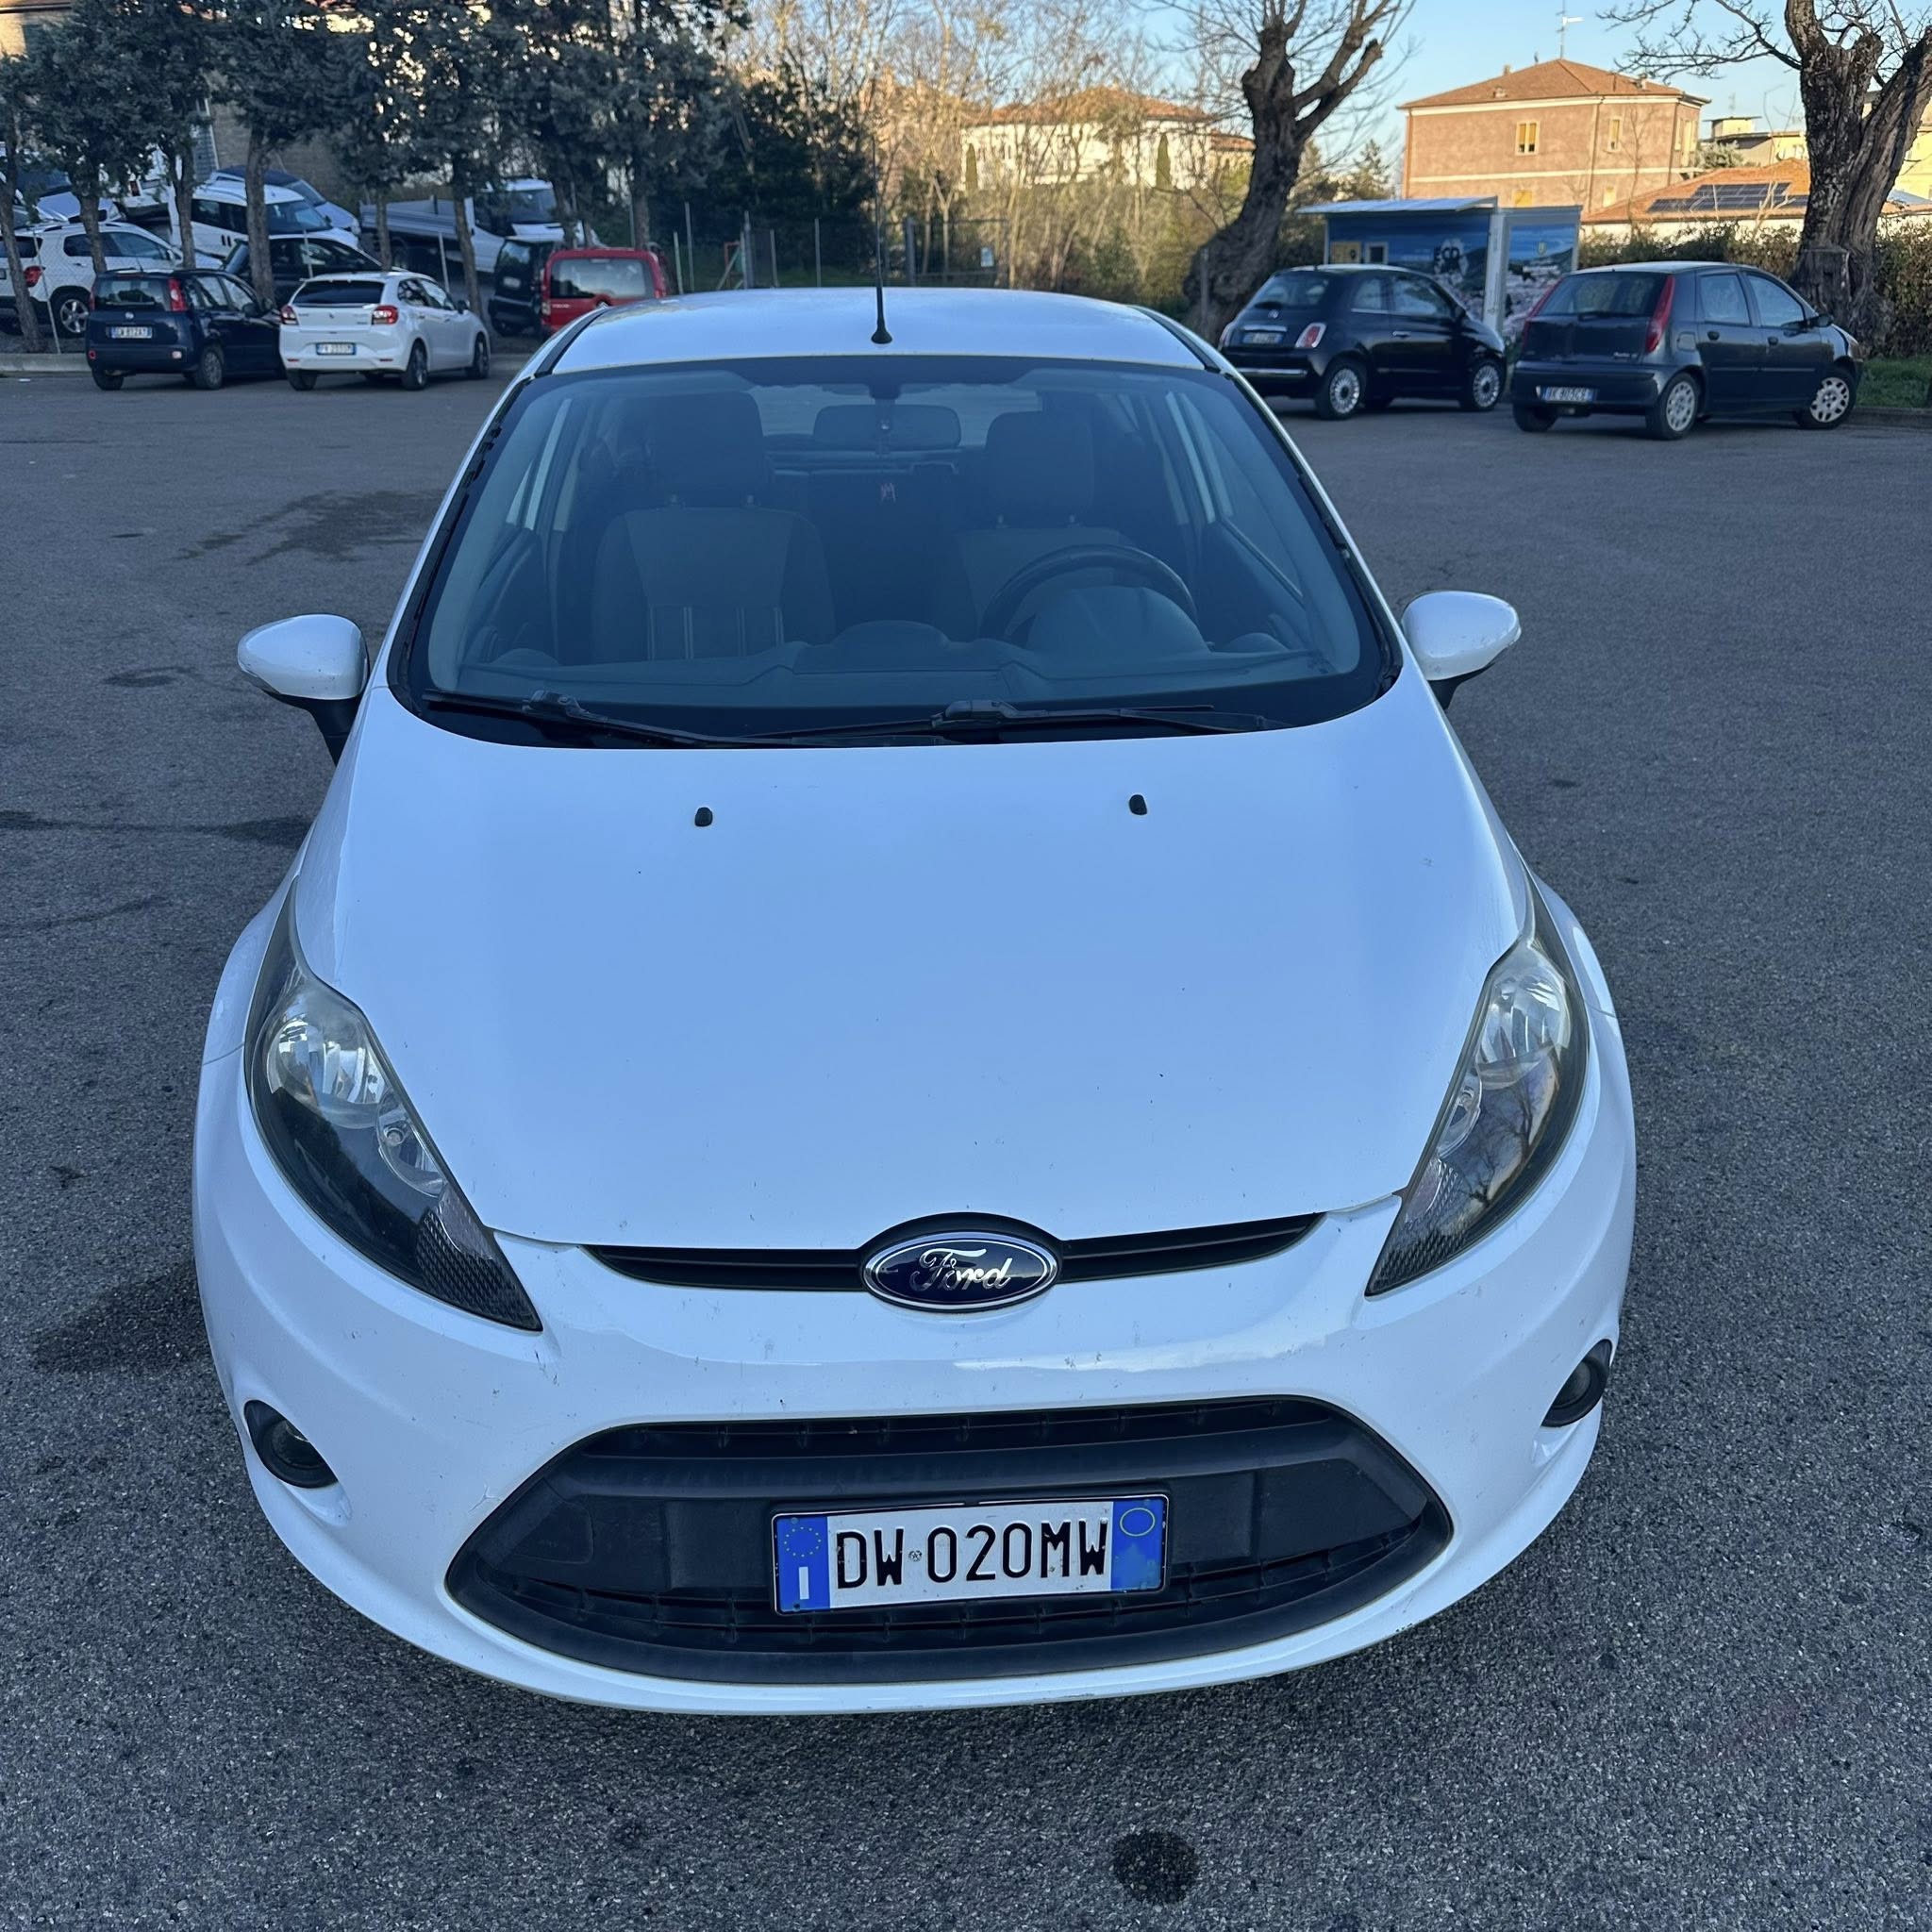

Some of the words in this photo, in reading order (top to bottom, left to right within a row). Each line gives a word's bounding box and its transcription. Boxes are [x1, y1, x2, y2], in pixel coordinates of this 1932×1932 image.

[909, 1247, 1013, 1291] Ford
[836, 1527, 905, 1590] DW
[926, 1519, 1108, 1584] 020MW
